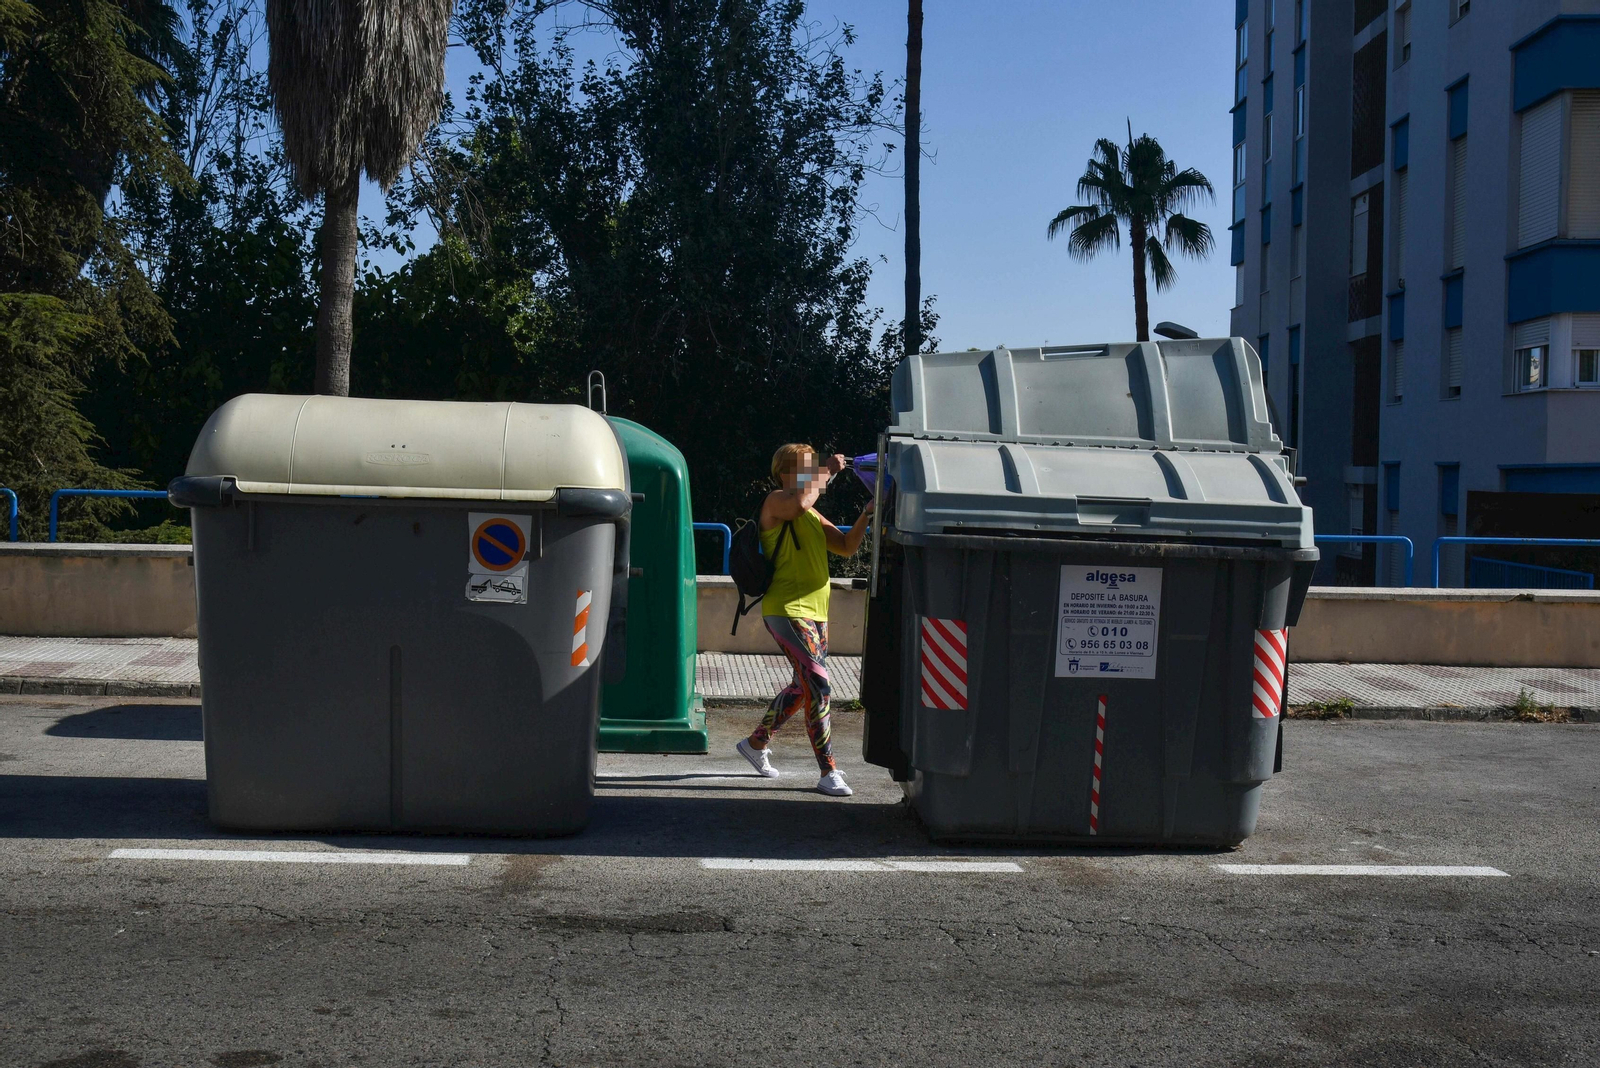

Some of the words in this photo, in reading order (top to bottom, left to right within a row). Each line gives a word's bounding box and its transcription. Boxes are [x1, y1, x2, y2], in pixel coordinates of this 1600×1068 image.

[1086, 570, 1136, 584] algesa
[1071, 592, 1105, 601] DEPOSITE
[1107, 593, 1117, 601] LA
[1119, 593, 1149, 602] BASURA
[1101, 626, 1128, 637] 010
[1080, 640, 1100, 649] 956
[1103, 640, 1116, 649] 65
[1120, 640, 1132, 649] 03
[1136, 641, 1149, 650] 08
